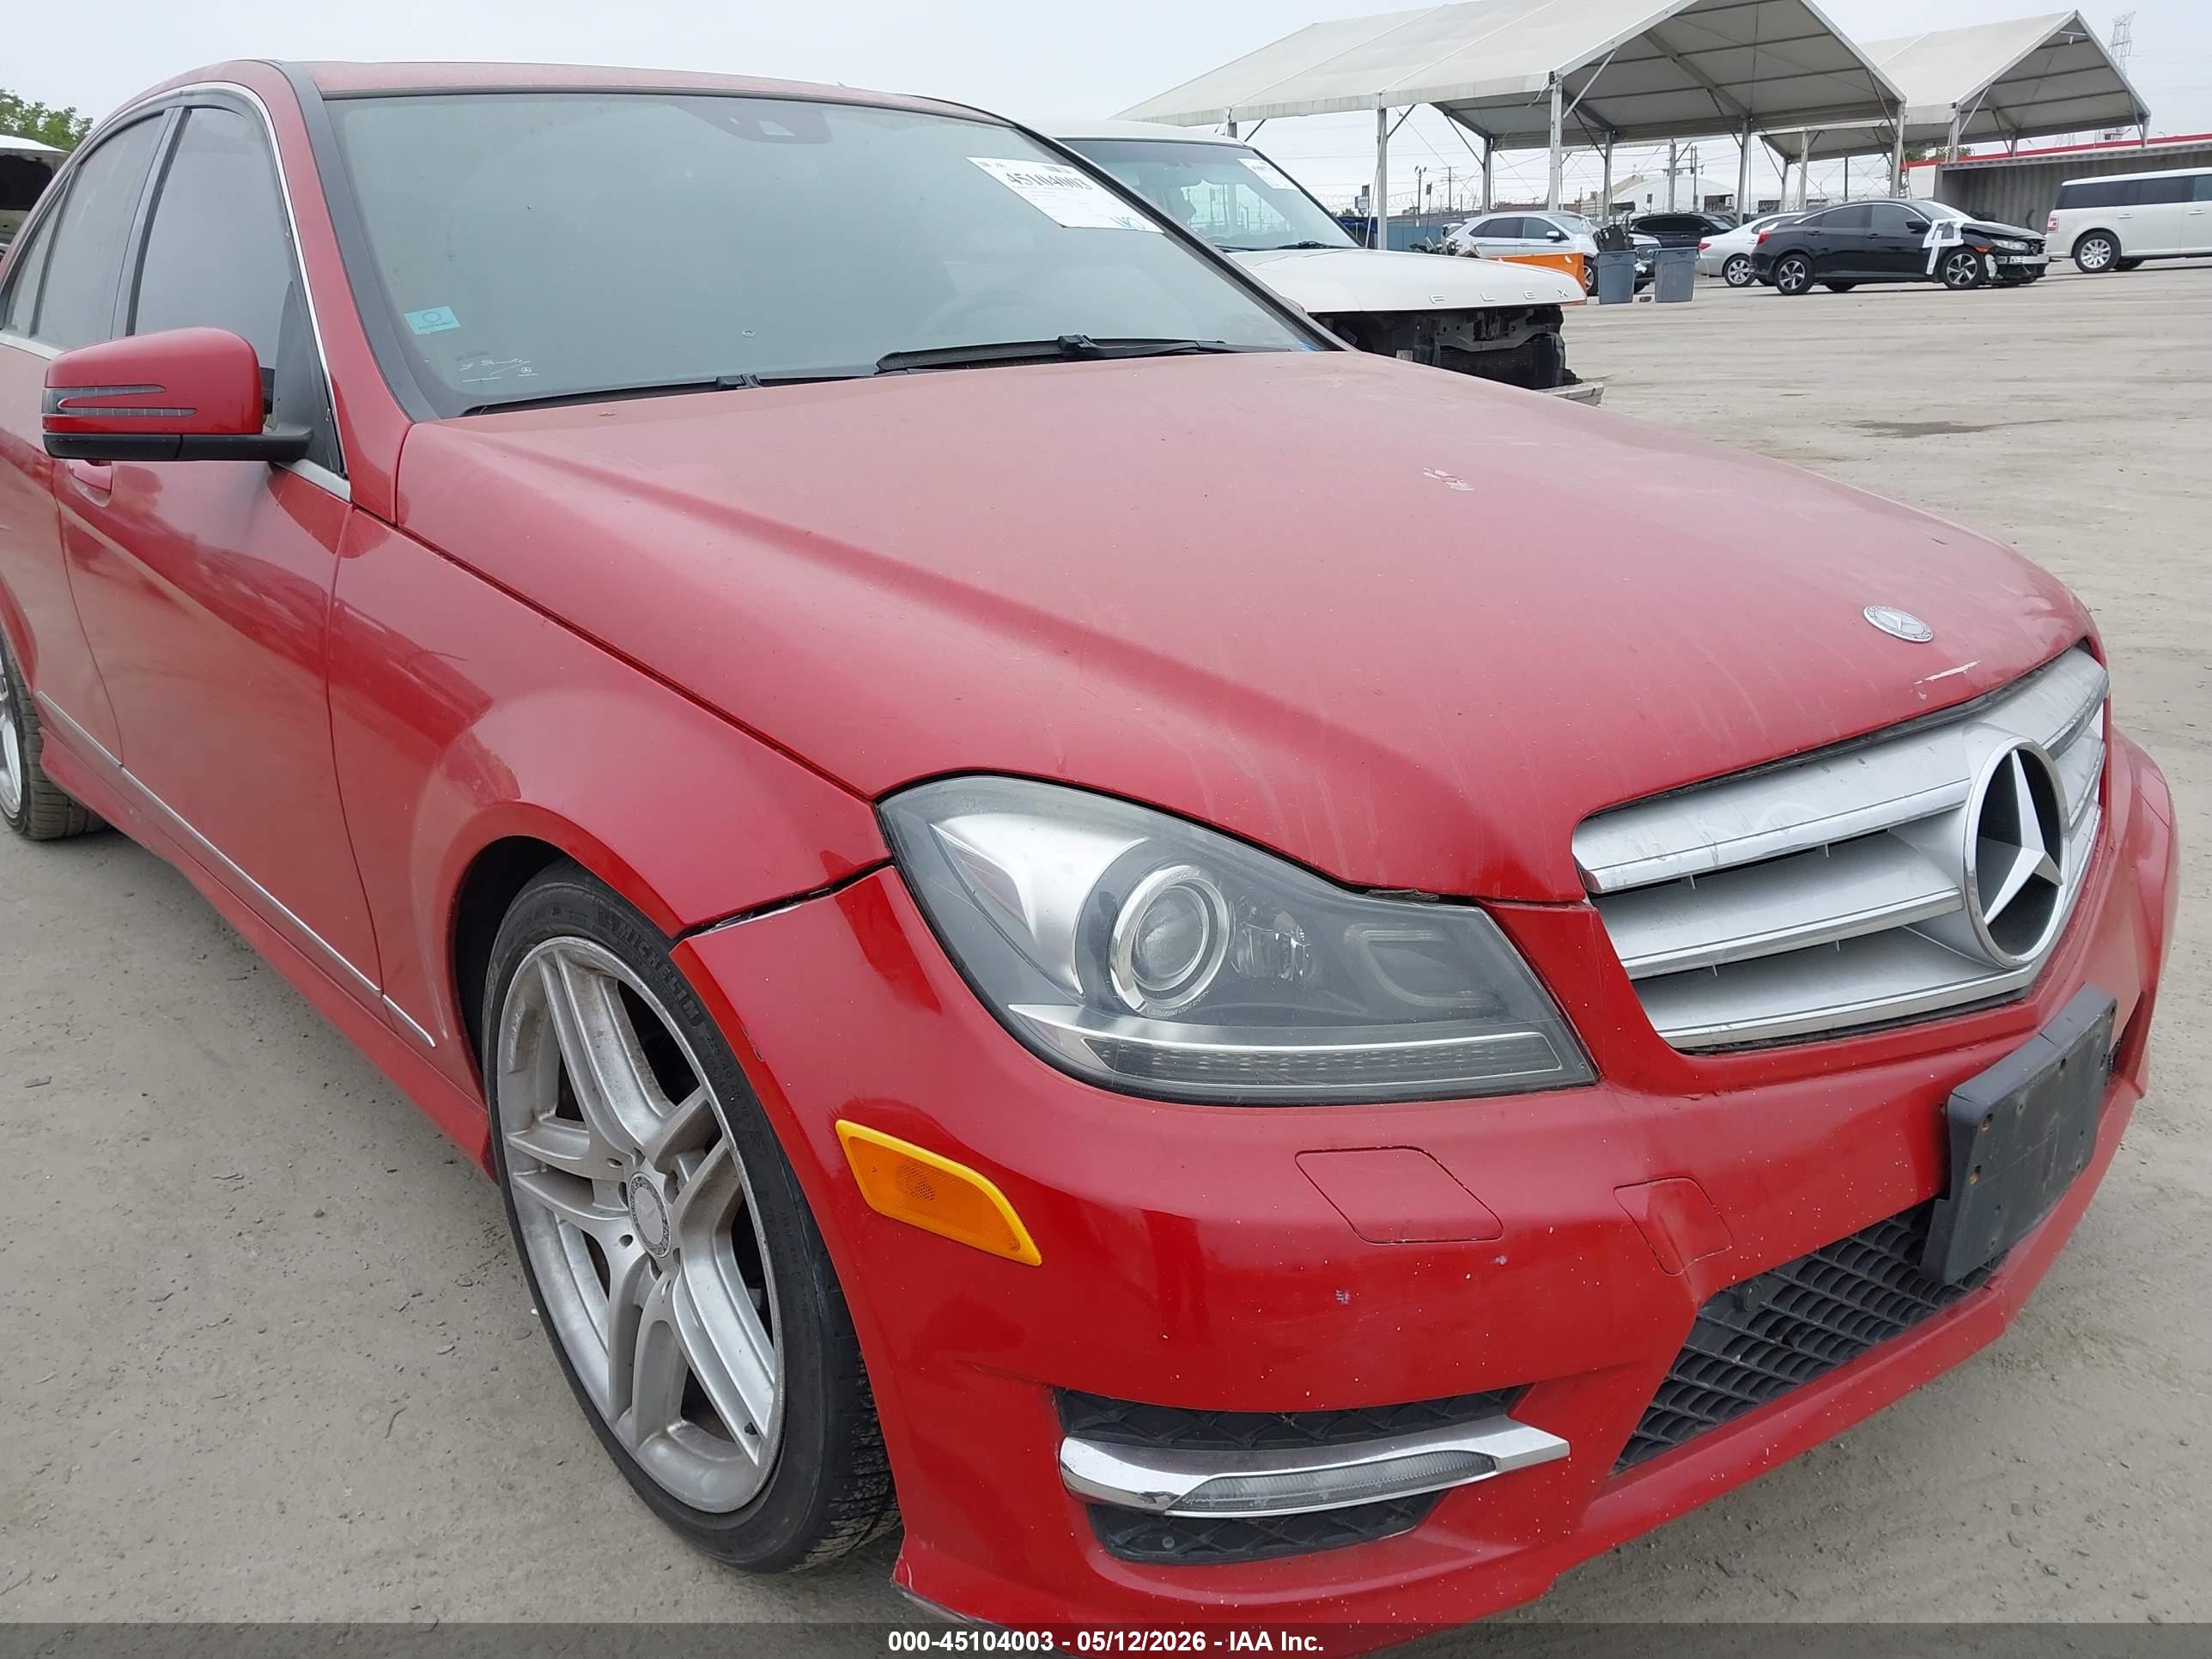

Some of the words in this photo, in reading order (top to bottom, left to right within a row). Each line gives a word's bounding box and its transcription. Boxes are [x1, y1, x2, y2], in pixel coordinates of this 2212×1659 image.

[1005, 172, 1093, 191] 45104003
[1429, 289, 1569, 304] FLEX
[615, 921, 702, 1020] MICHELIN
